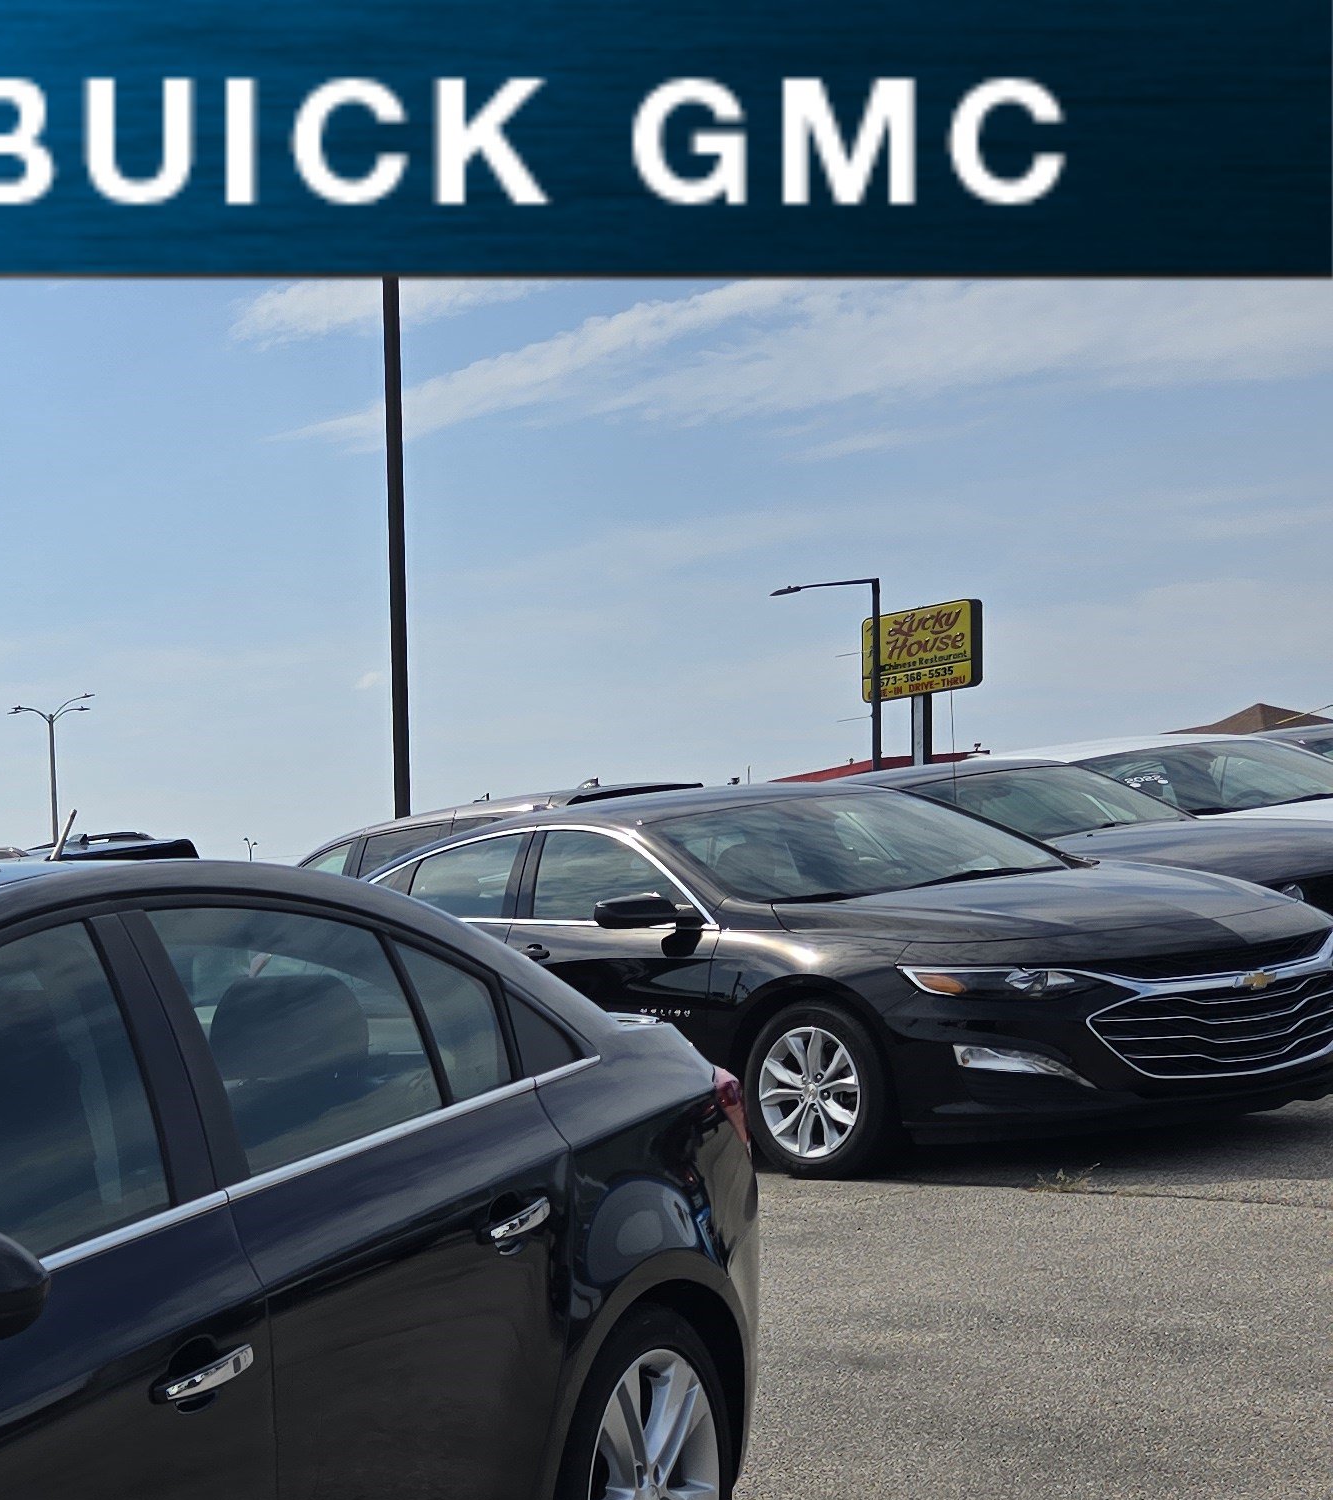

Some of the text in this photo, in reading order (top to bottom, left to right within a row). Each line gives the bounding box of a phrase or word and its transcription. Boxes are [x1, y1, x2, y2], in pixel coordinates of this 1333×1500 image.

[888, 608, 962, 637] Lucky
[886, 633, 965, 660] House
[918, 650, 967, 665] Restaurant
[908, 675, 966, 692] DRIVE-THRU
